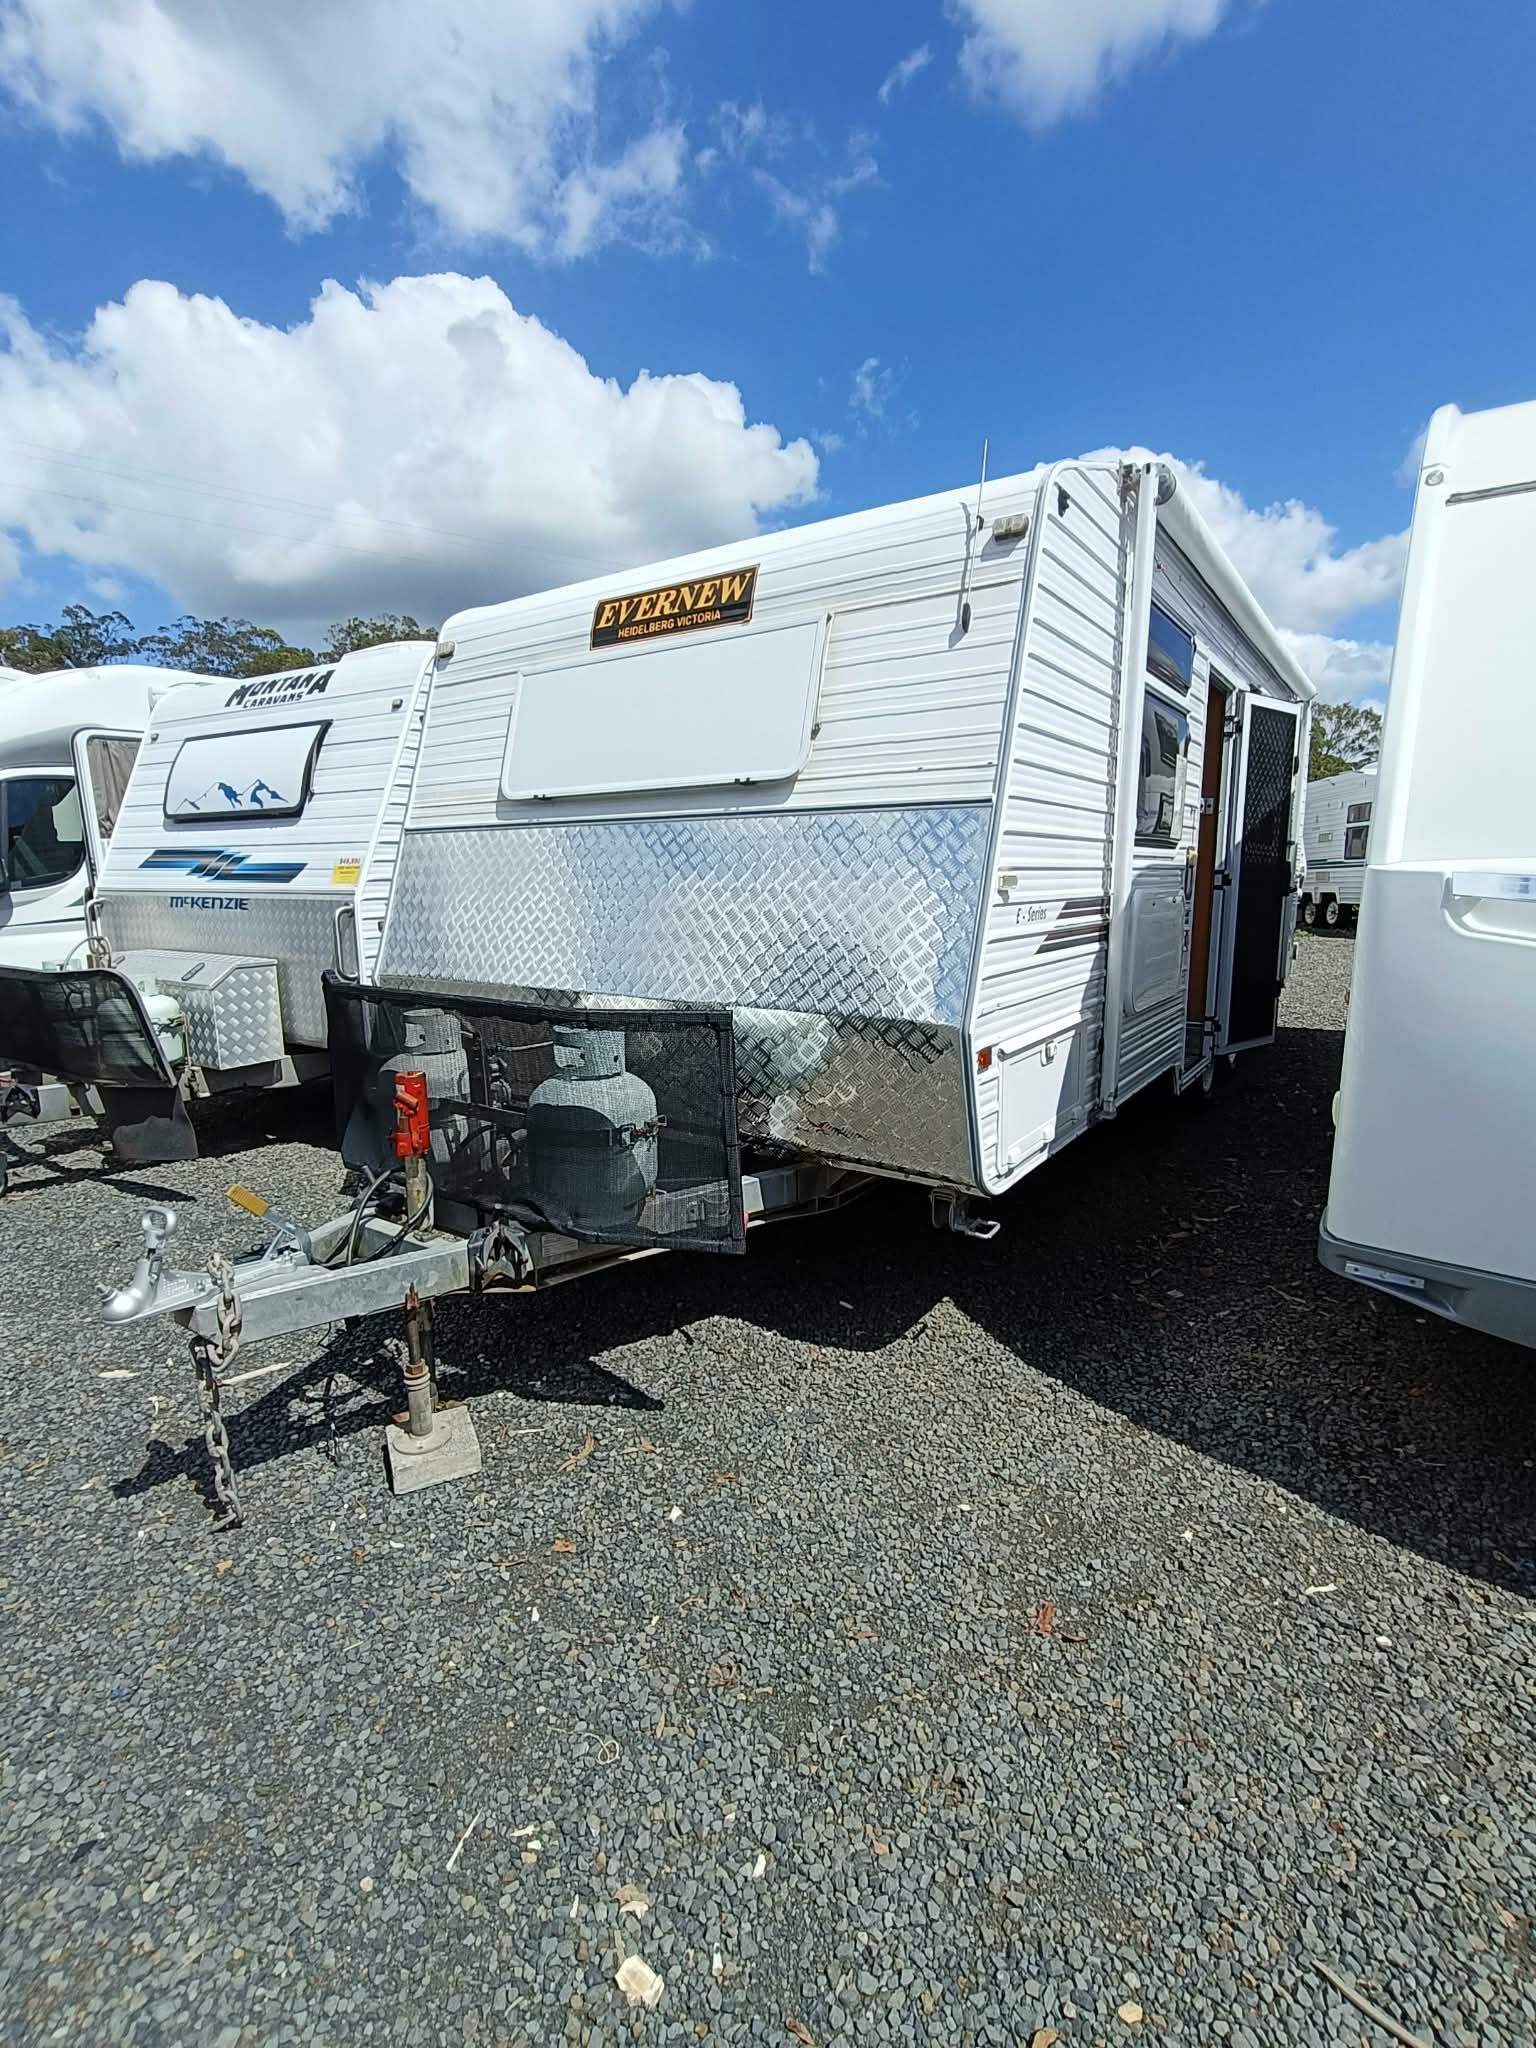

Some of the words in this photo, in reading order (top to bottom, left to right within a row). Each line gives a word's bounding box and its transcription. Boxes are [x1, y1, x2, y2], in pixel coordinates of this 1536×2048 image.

[596, 572, 753, 629] EVERNEW
[618, 619, 675, 639] HEIDELBERG
[676, 609, 721, 627] VICTORIA
[224, 669, 336, 708] MONTANA
[242, 691, 304, 709] CARAVANS
[1027, 906, 1048, 922] Series
